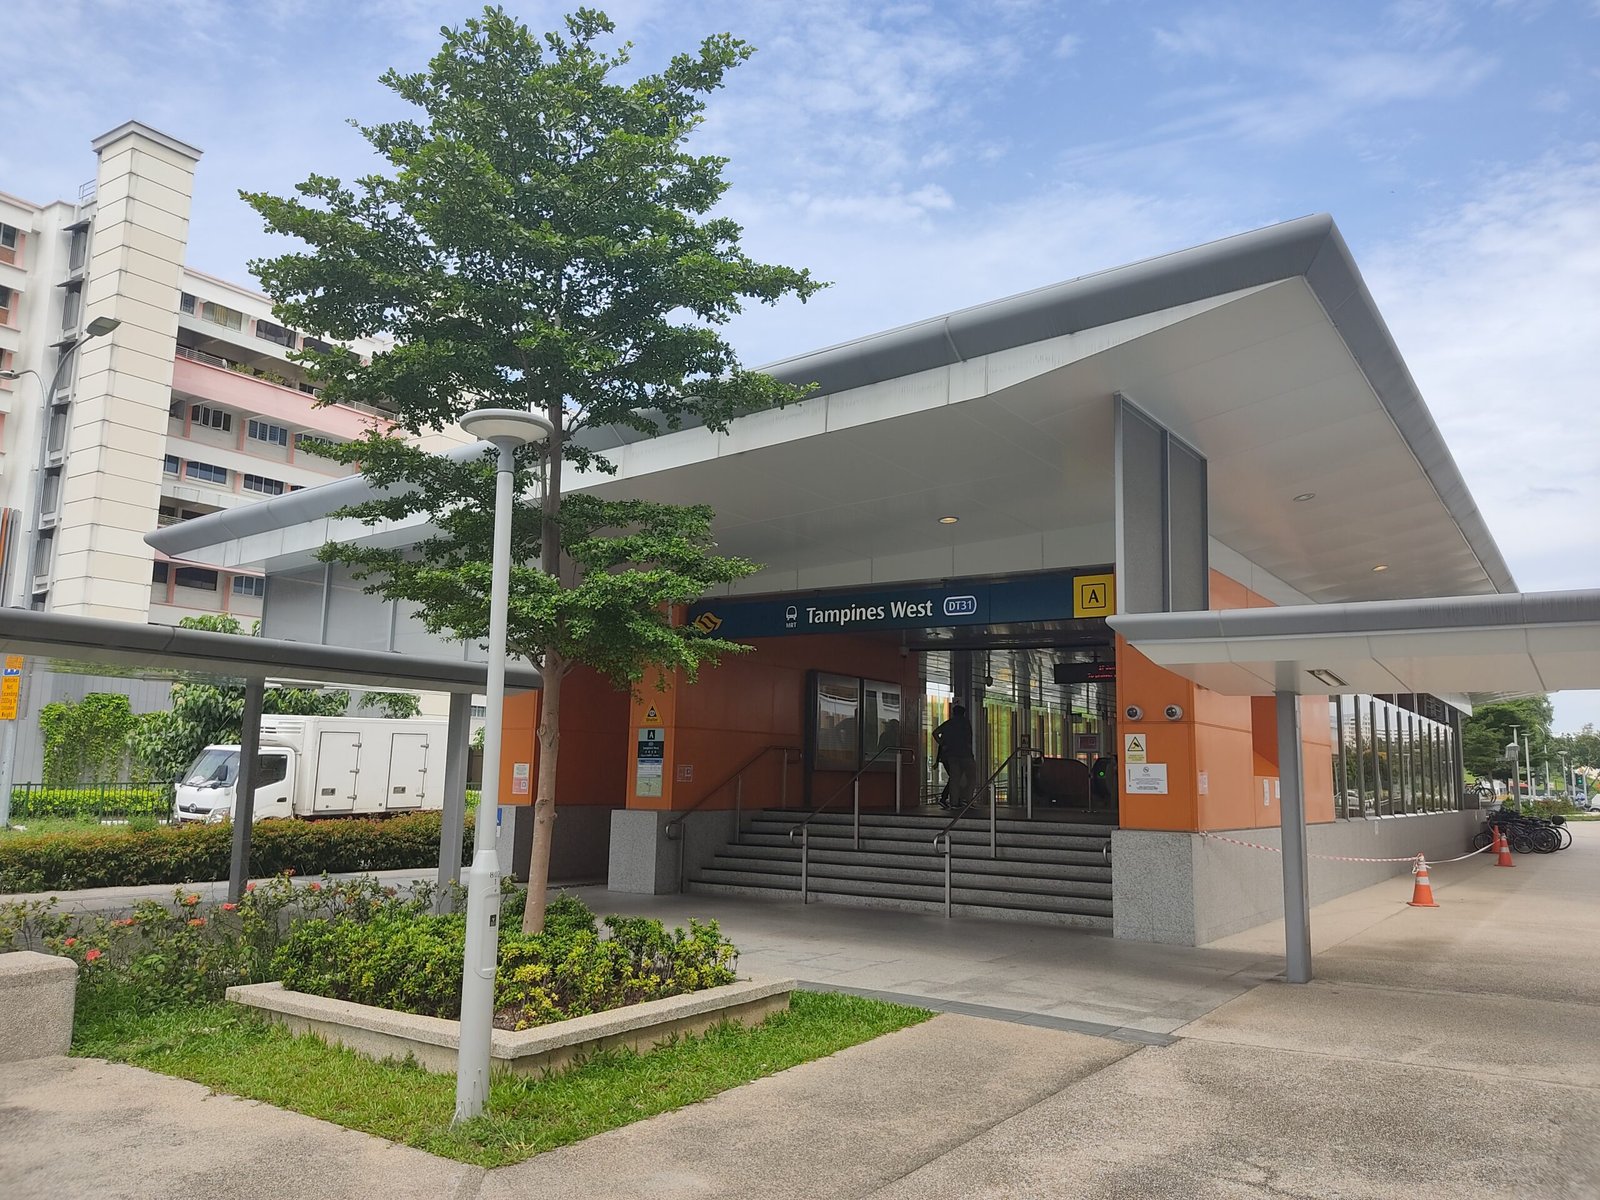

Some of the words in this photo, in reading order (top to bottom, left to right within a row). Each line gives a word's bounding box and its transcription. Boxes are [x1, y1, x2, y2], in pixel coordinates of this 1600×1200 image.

[1088, 589, 1099, 603] A
[948, 600, 972, 611] DT31
[806, 604, 885, 626] Tampines
[890, 600, 933, 618] West
